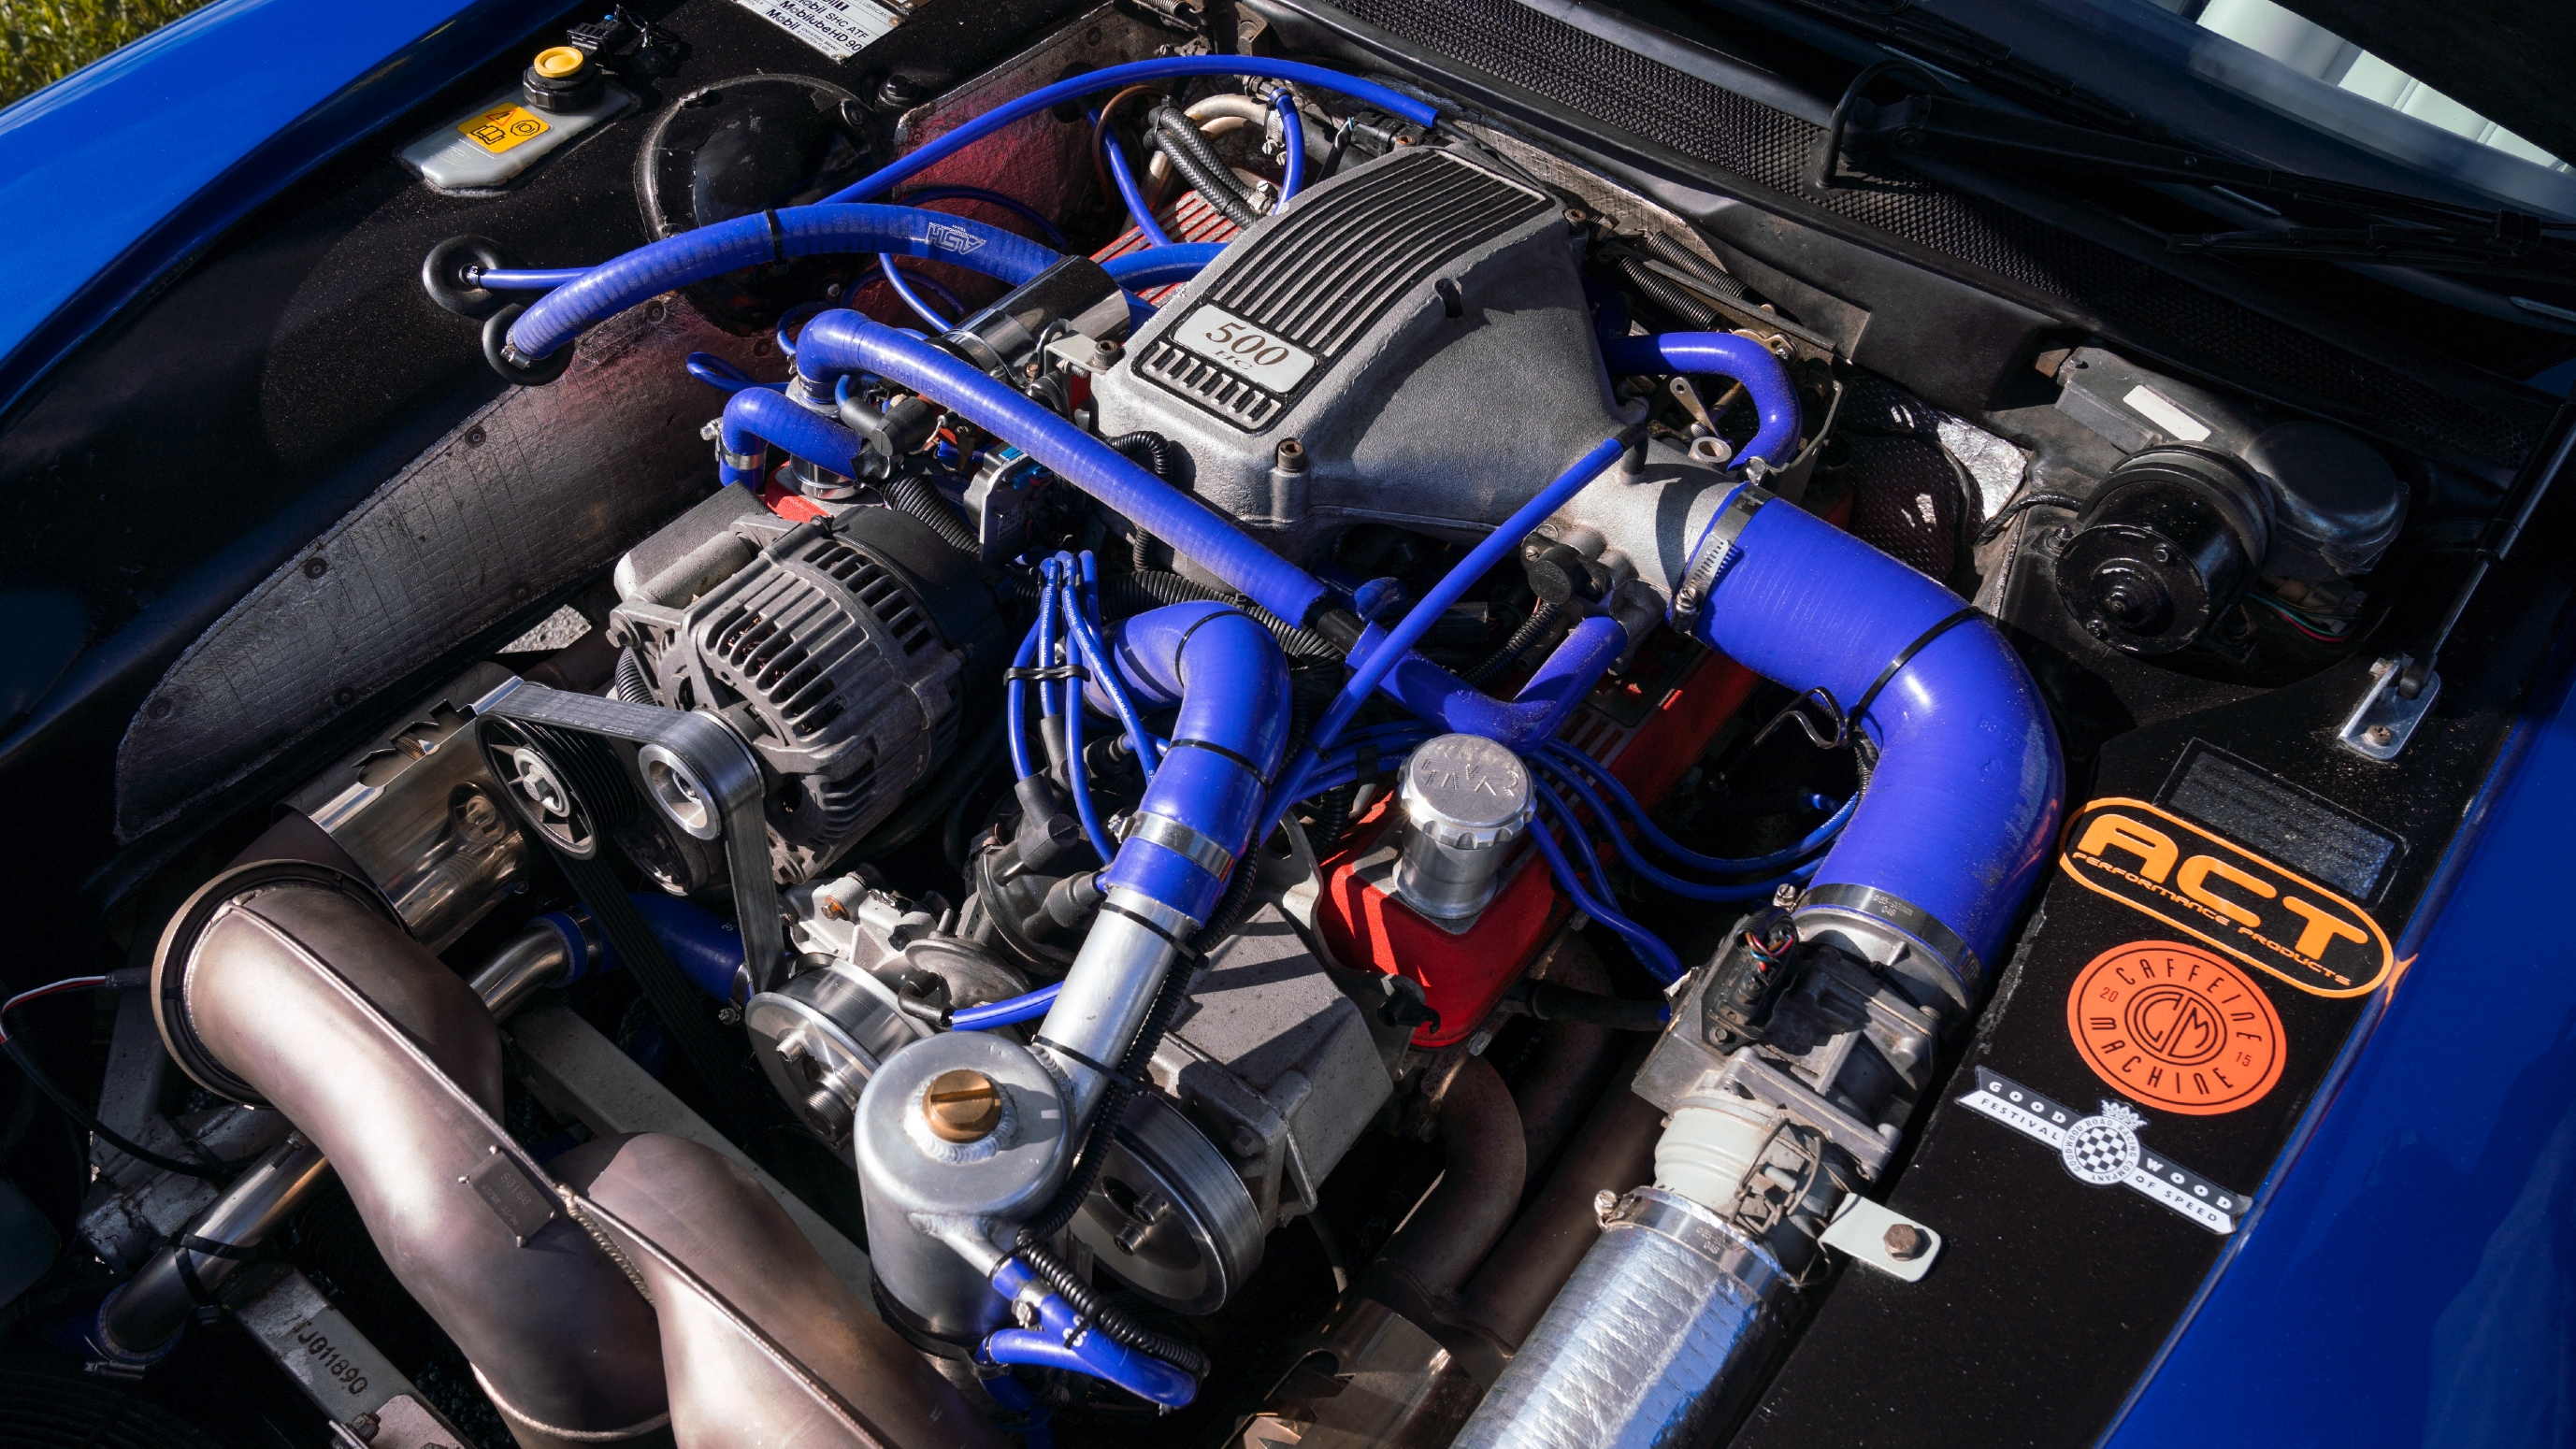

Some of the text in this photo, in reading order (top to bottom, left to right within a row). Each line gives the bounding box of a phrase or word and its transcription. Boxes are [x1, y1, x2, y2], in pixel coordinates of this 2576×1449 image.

[767, 8, 801, 31] Mobil
[799, 0, 869, 39] obil SHC ATF
[859, 1, 892, 19] LUBRICANT
[845, 40, 862, 51] 90
[1205, 322, 1289, 366] 500
[1211, 351, 1254, 370] HC
[1043, 583, 1054, 629] Performance
[1076, 628, 1090, 650] Silicon
[1040, 681, 1048, 702] eads
[2077, 813, 2368, 960] ACT
[2071, 852, 2352, 986] PERFORMANCE PRODUCTS
[2115, 957, 2262, 1042] CAFFEINE
[2099, 986, 2252, 1068] 20 15
[2089, 1016, 2234, 1096] MACHINE
[1980, 1098, 2217, 1223] FESTIVAL OF SPEED
[1989, 1081, 2233, 1210] GOOD WOOD
[2065, 1118, 2137, 1182] GOODWOOD ROAD RACING COMPANY
